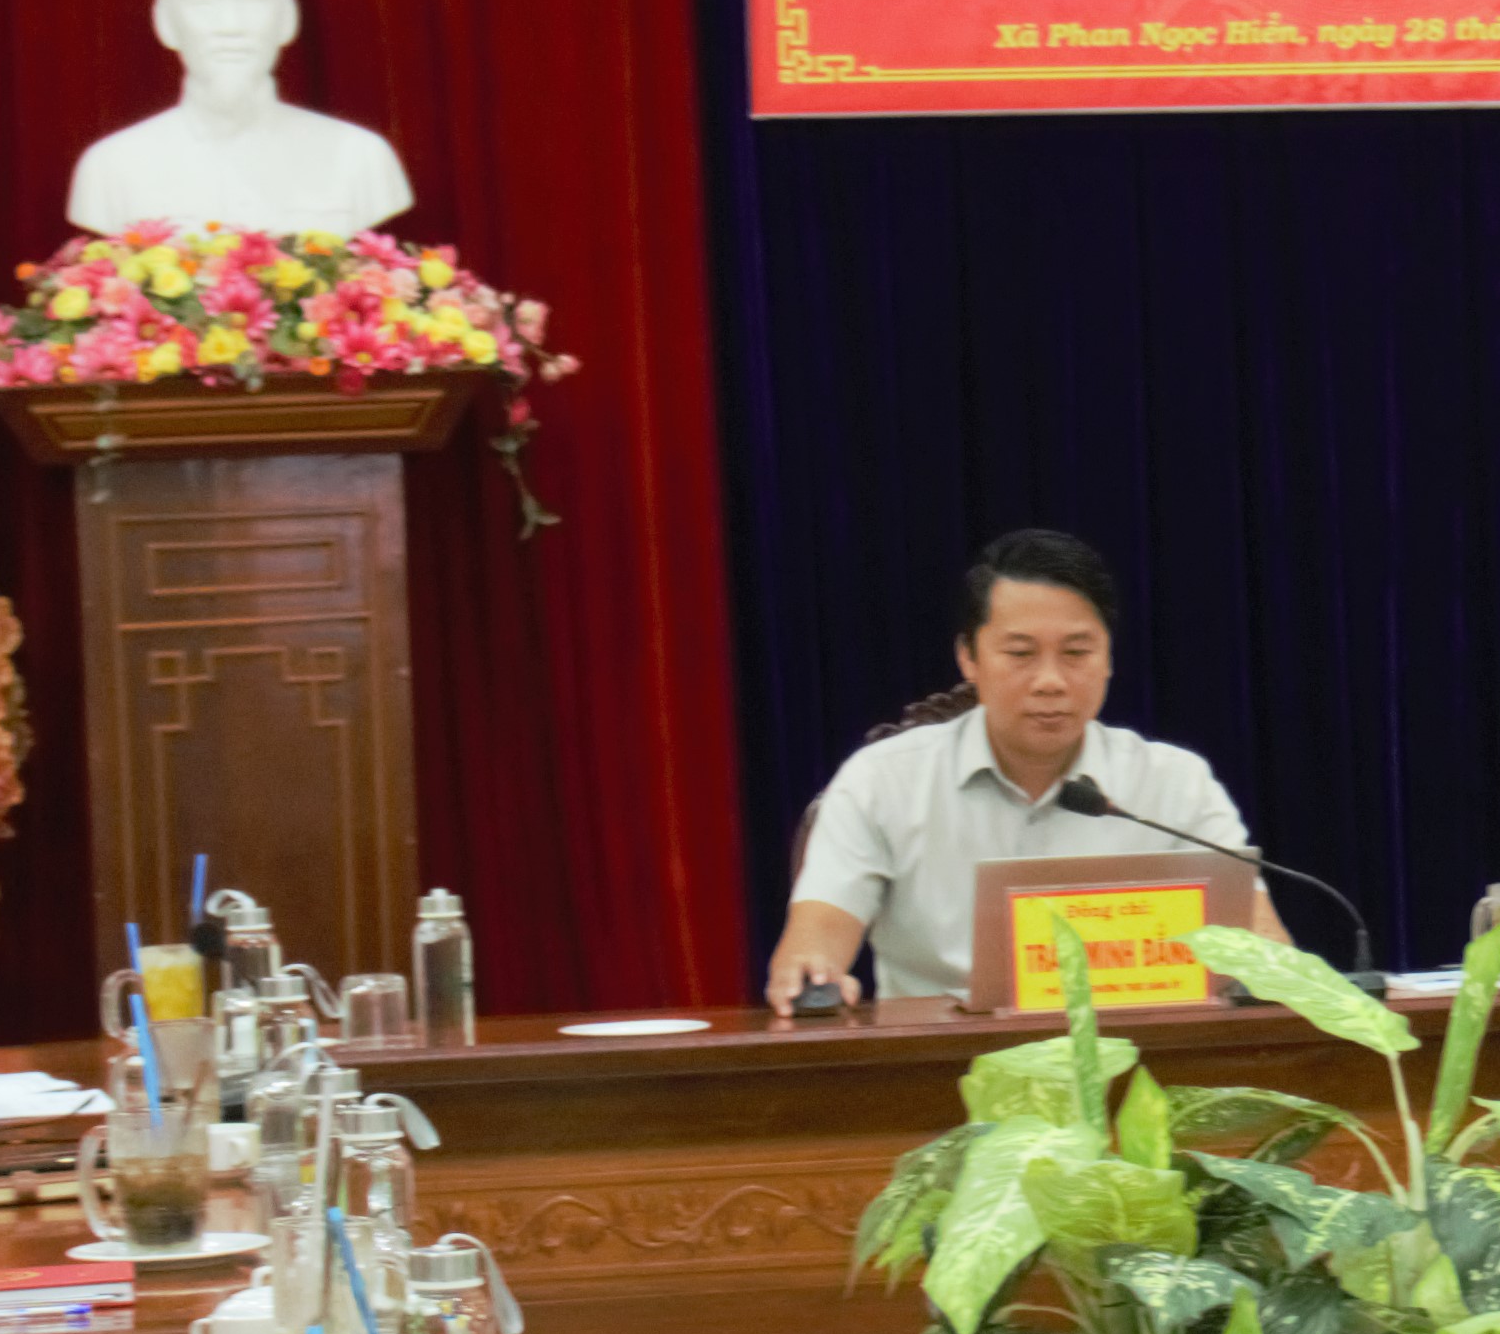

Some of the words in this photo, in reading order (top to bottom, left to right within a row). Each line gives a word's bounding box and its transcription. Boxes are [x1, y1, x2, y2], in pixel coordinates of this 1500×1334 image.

[1046, 22, 1131, 48] Phan
[1139, 21, 1218, 52] Ngọc
[1317, 17, 1397, 50] ngày
[1403, 17, 1447, 42] 28
